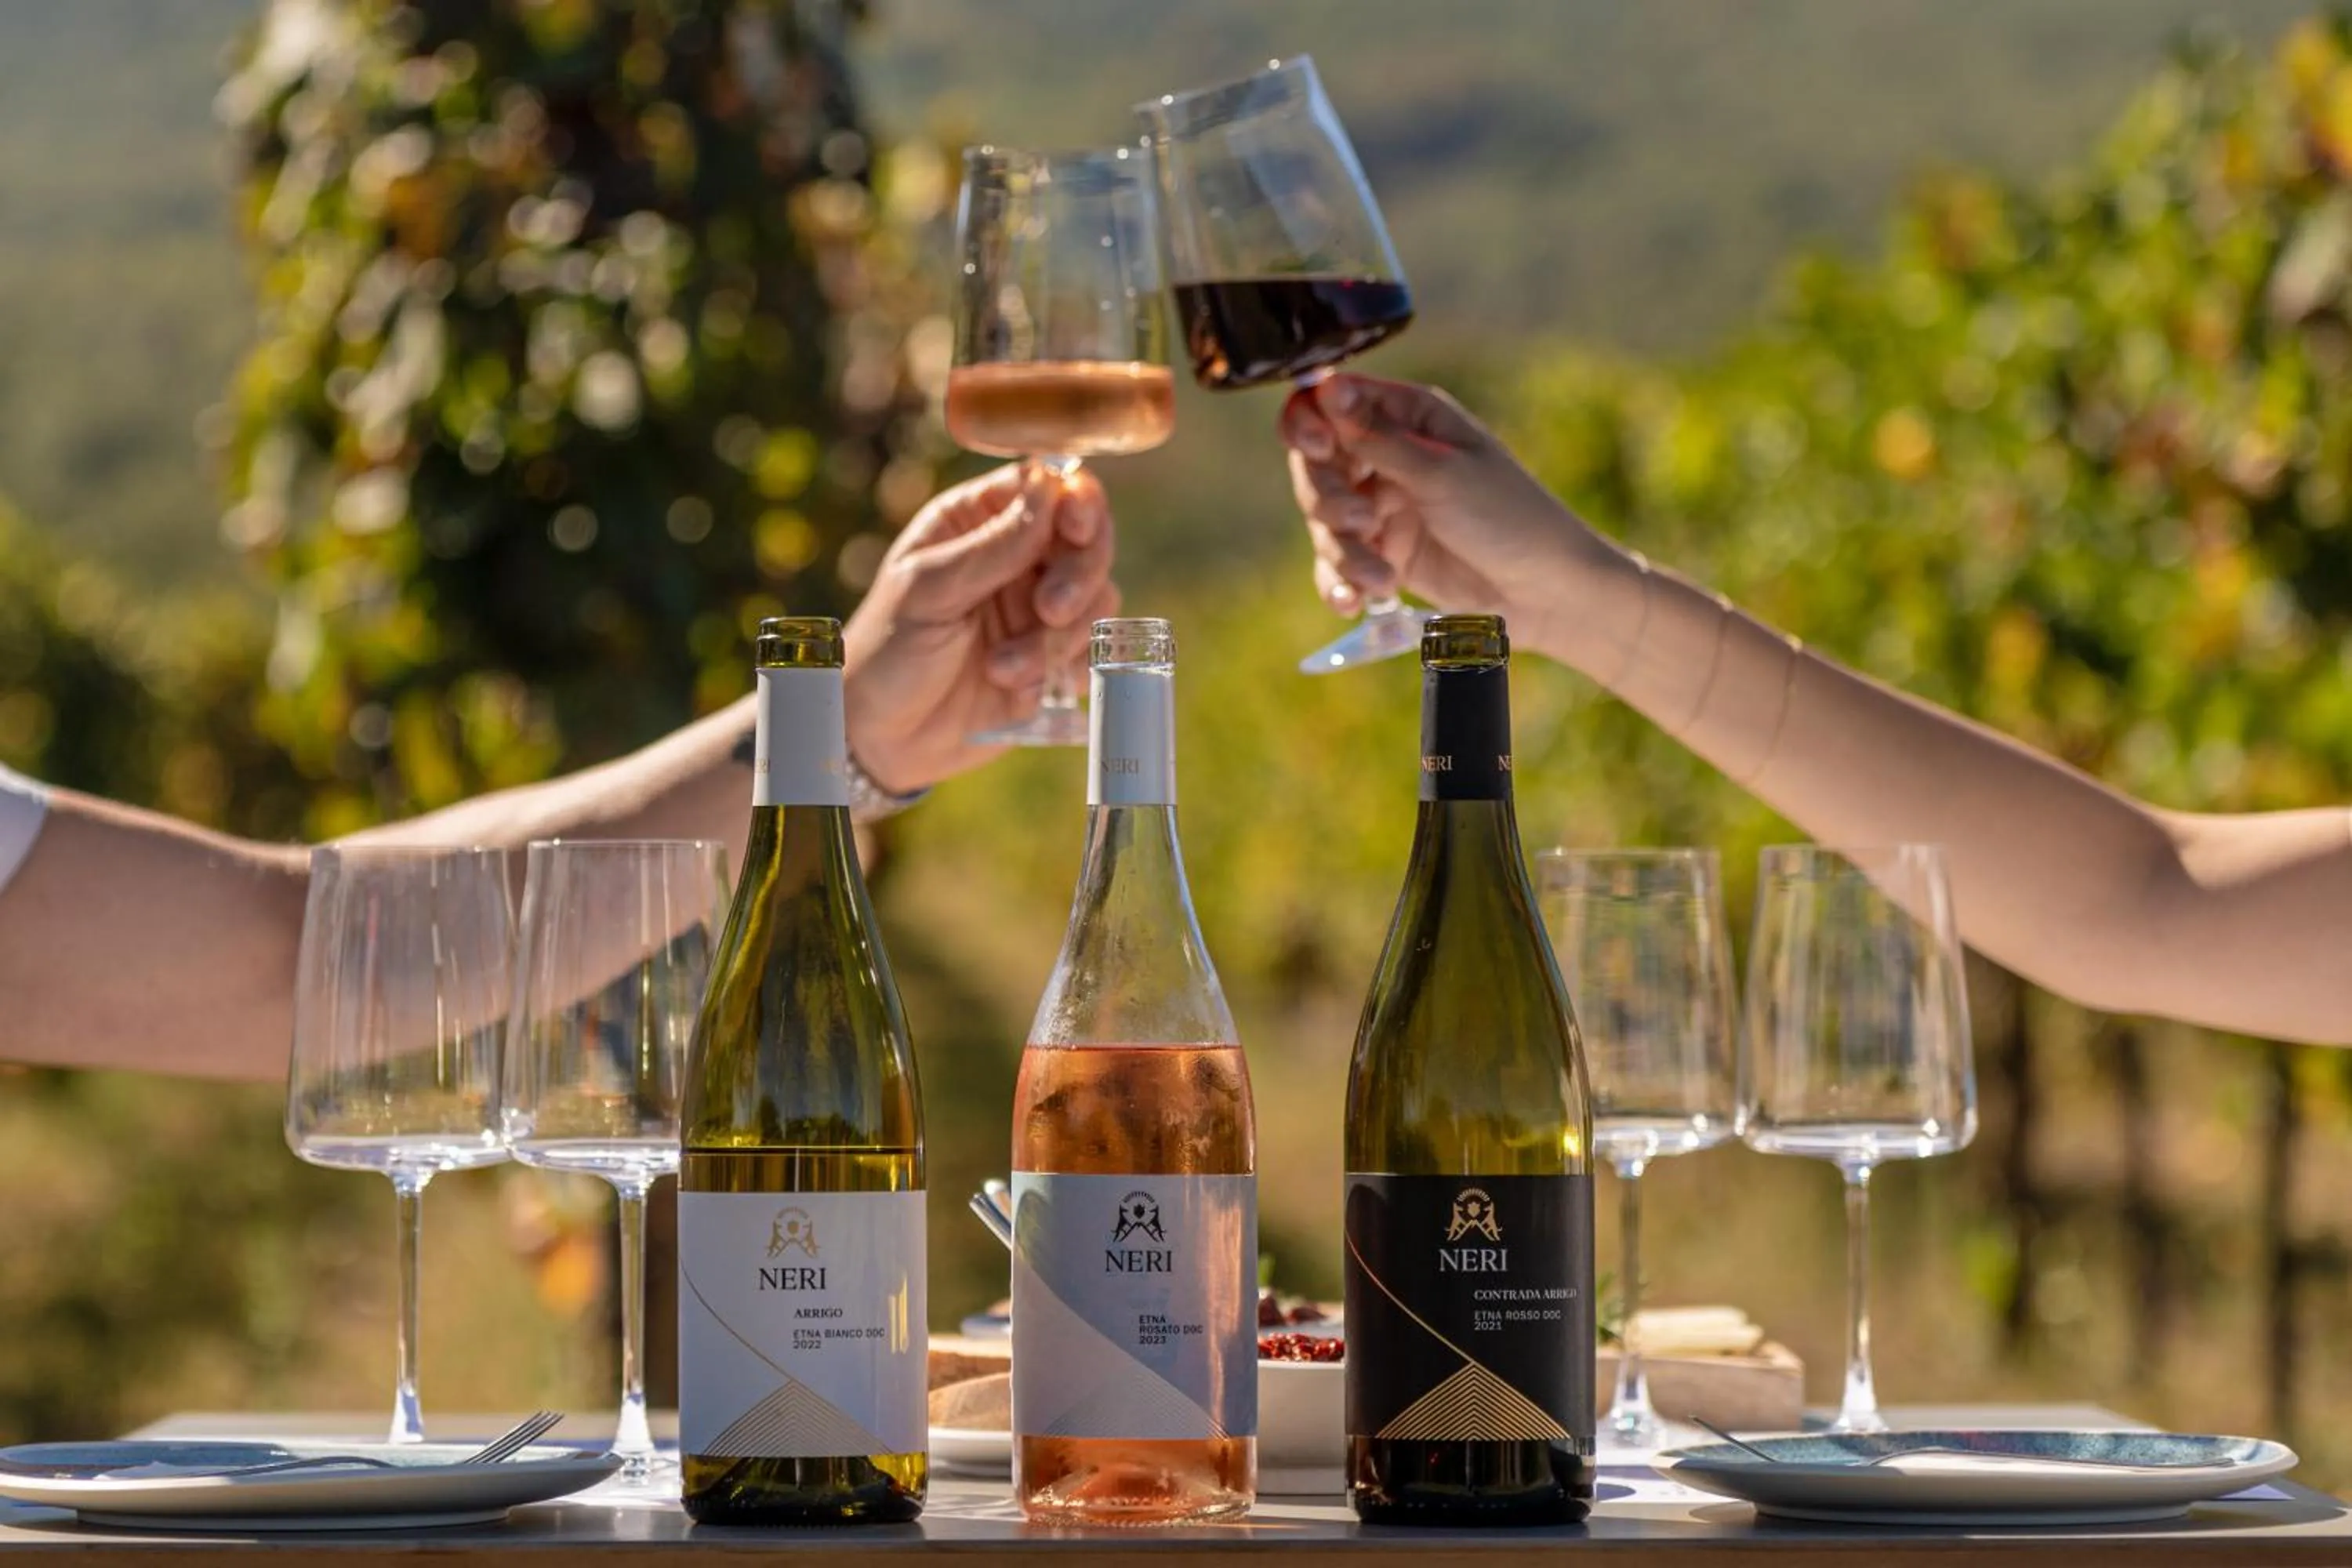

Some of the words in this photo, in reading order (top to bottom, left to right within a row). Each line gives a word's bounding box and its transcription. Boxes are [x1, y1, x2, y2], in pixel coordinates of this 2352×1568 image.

[1105, 1250, 1173, 1273] NERI
[1438, 1248, 1508, 1272] NERI
[758, 1267, 826, 1290] NERI
[1473, 1289, 1541, 1301] CONTRADA
[793, 1307, 844, 1319] ARRIGO
[1474, 1310, 1502, 1321] ETNA
[1505, 1309, 1541, 1321] ROSSO
[1138, 1315, 1167, 1324] ETNA
[1474, 1320, 1502, 1331] 2021
[793, 1328, 822, 1339] ETNA
[825, 1328, 863, 1339] BIANCO
[866, 1327, 886, 1338] DOC
[1138, 1325, 1181, 1334] ROSATO
[1183, 1325, 1203, 1334] DOC
[793, 1339, 822, 1350] 2022
[1138, 1335, 1167, 1345] 2023
